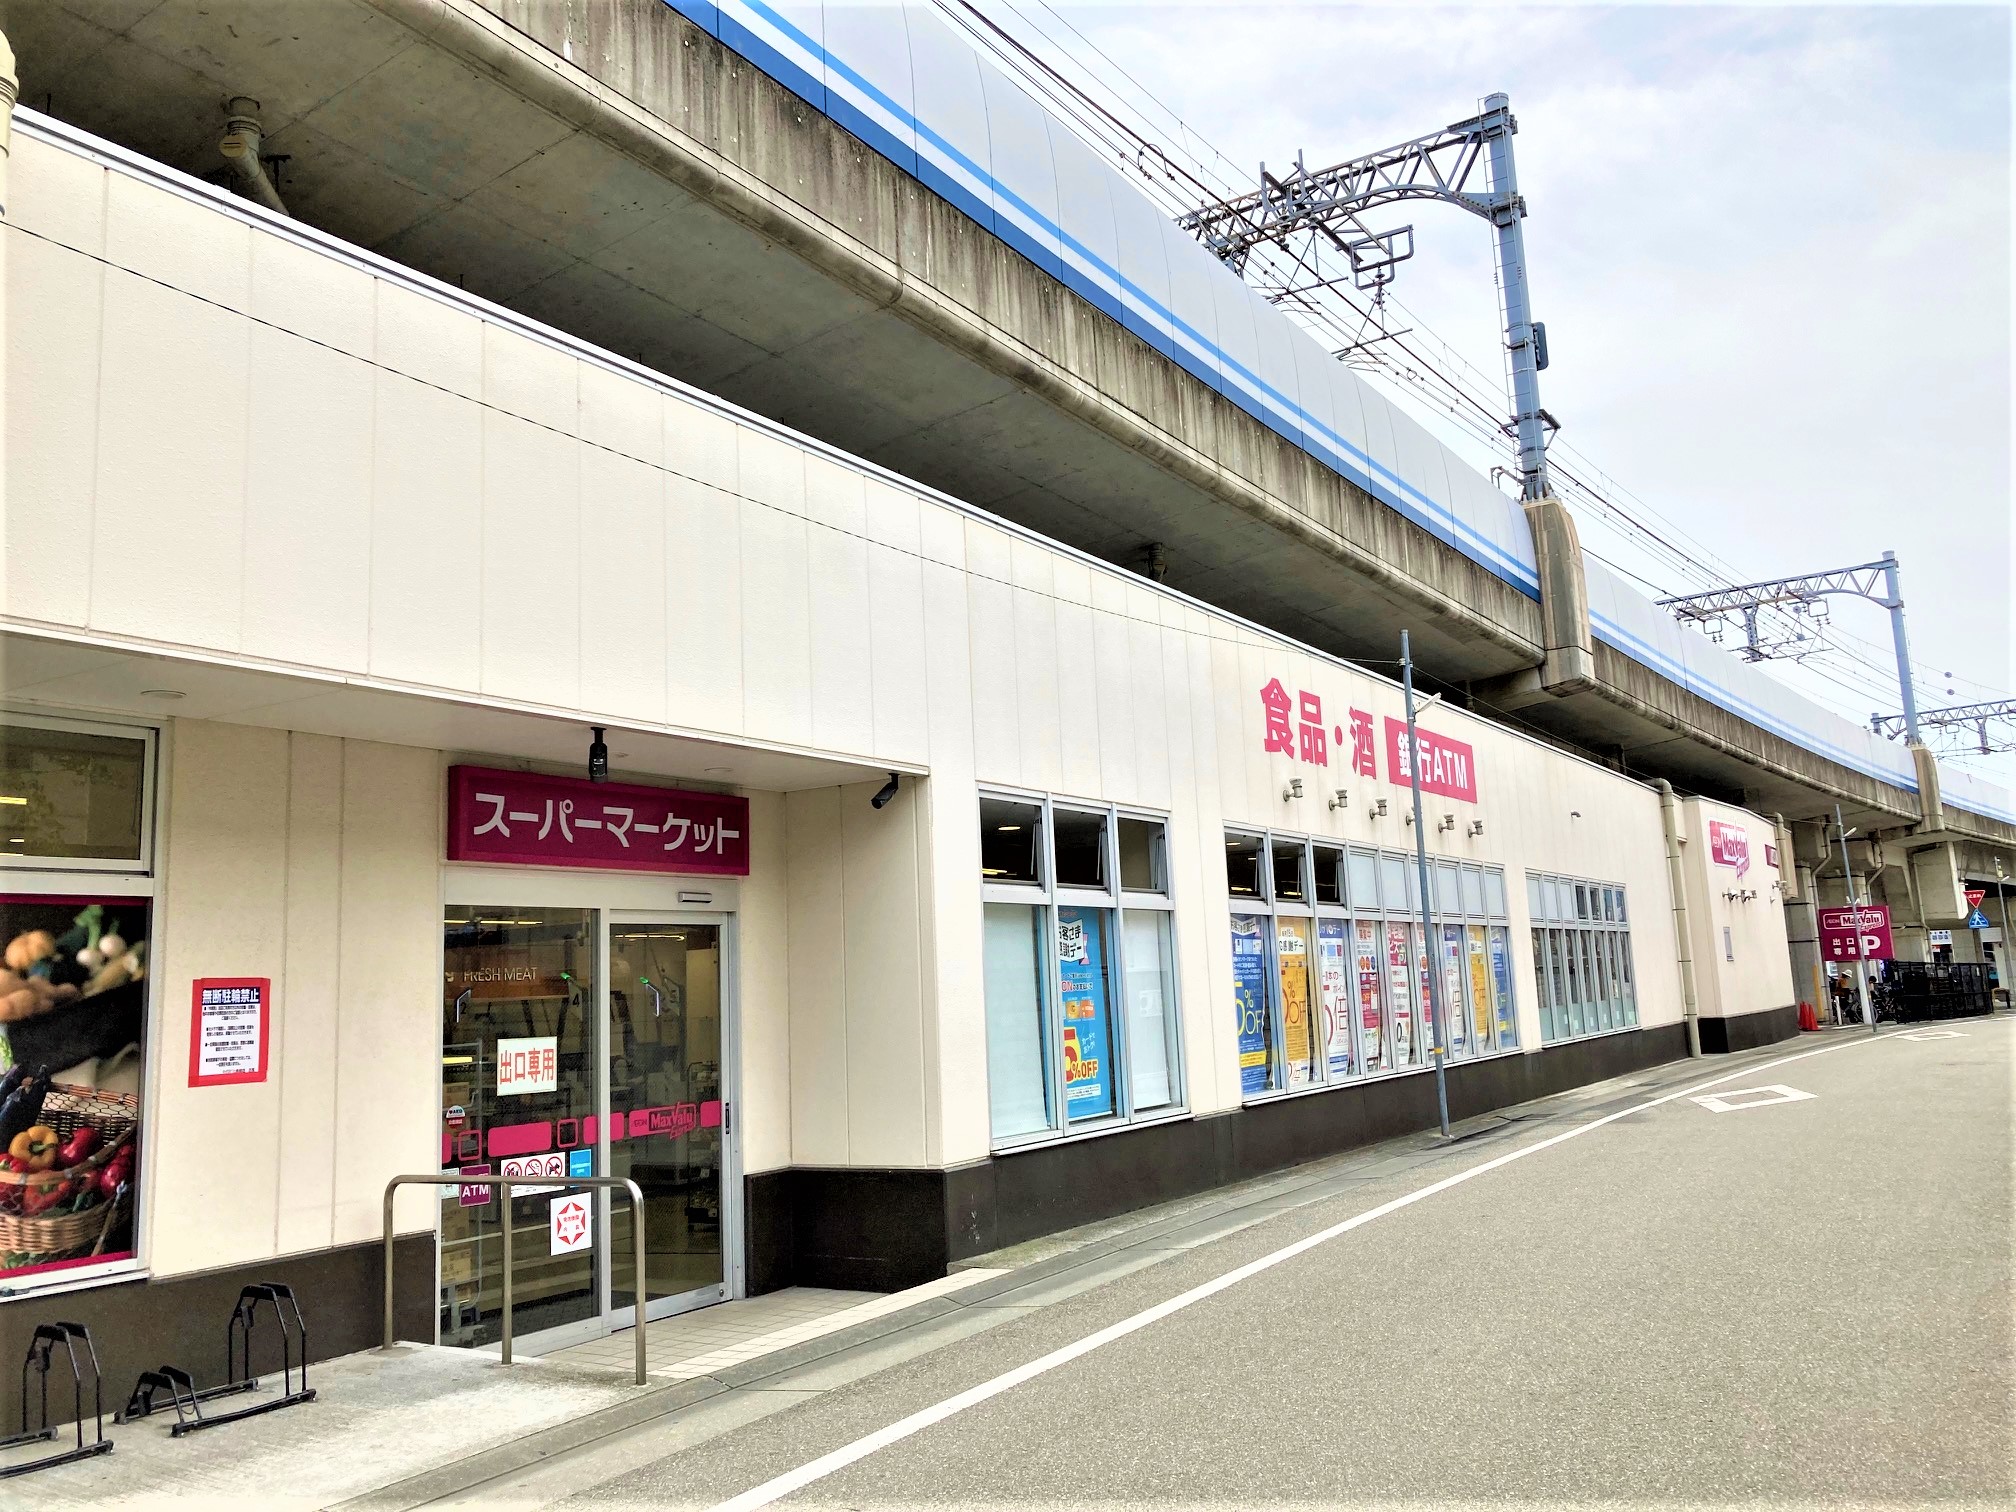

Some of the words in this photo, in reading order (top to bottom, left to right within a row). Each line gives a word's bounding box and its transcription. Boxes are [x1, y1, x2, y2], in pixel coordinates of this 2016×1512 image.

[1260, 677, 1377, 780] 食品・酒
[473, 792, 740, 855] スーパーマーケット
[1861, 935, 1881, 956] P
[463, 967, 501, 982] FRESH
[504, 966, 538, 981] MEAT
[202, 989, 259, 1004] 無断駐輪禁止
[499, 1048, 554, 1085] 出口専用
[650, 1102, 694, 1129] MaxValu
[461, 1184, 489, 1198] ATM
